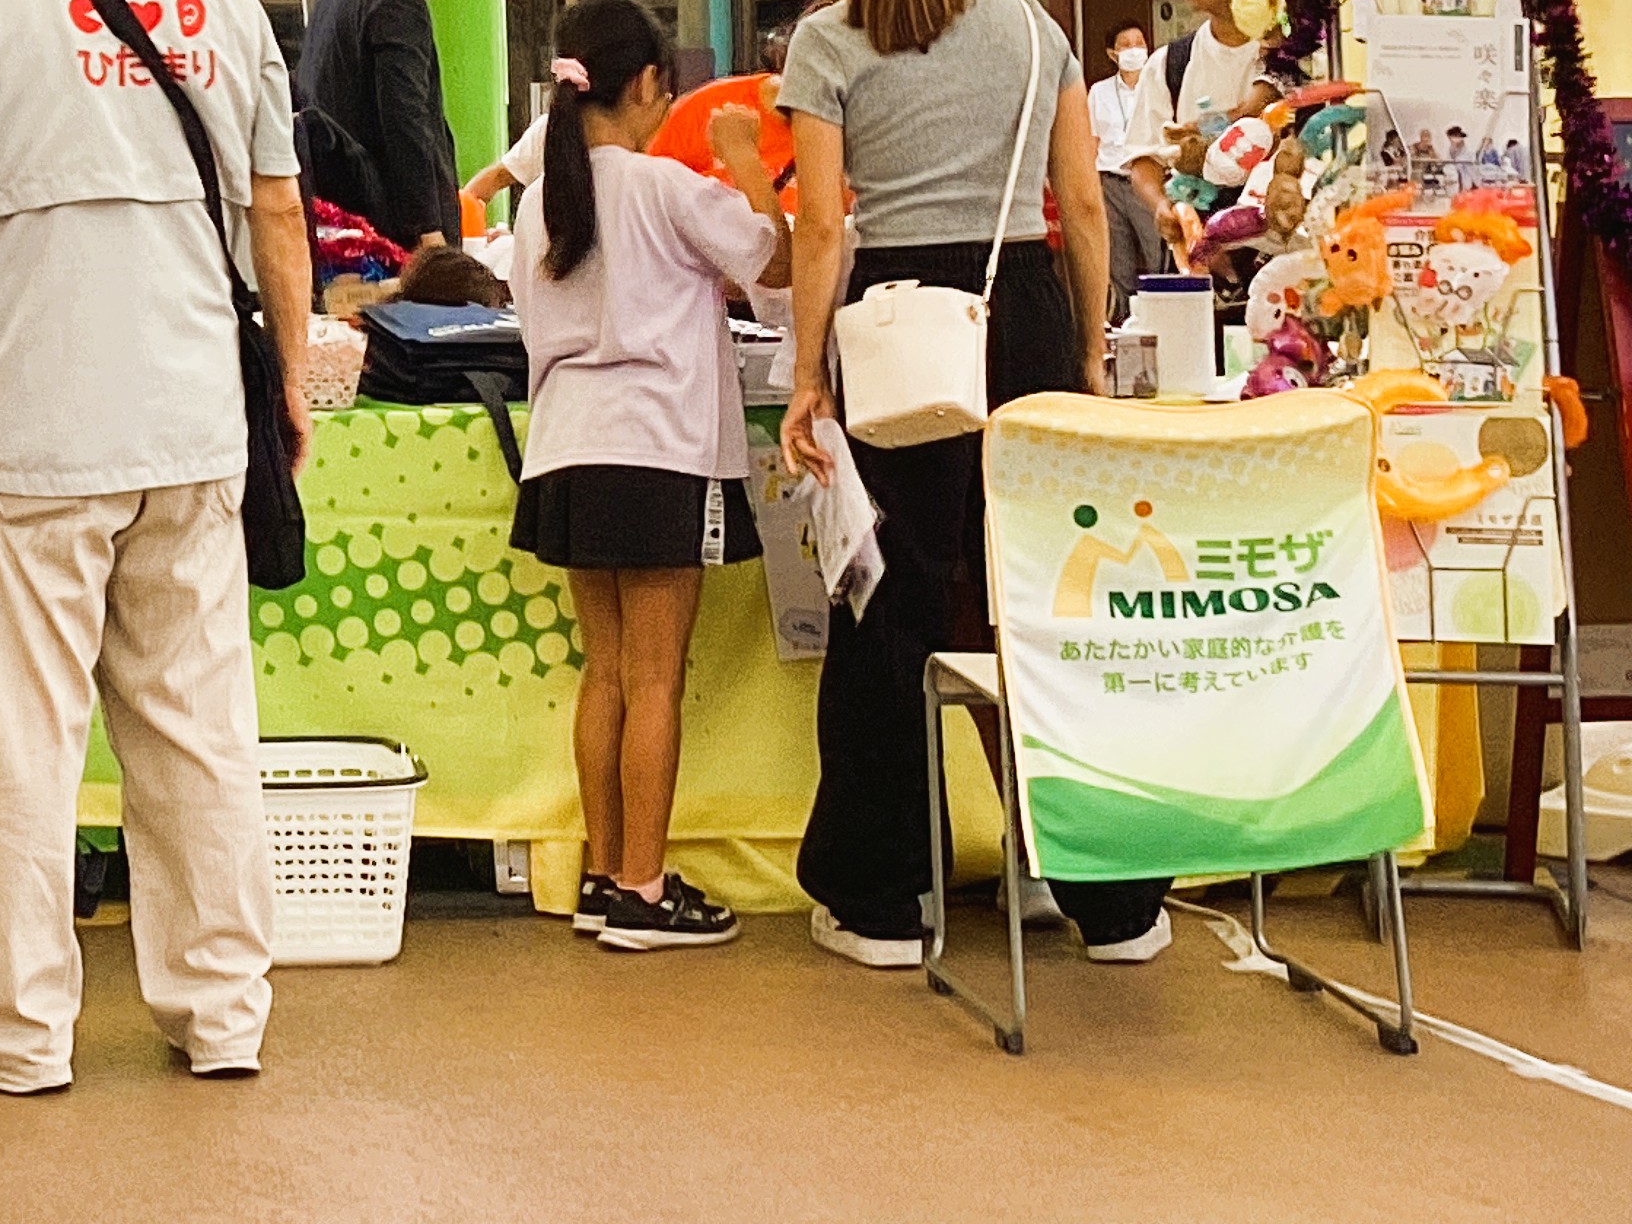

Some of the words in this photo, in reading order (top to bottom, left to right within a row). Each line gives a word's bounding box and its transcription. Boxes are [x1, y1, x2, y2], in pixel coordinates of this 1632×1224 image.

[1195, 529, 1334, 581] ミモザ
[1108, 582, 1341, 619] MIMOSA
[1059, 620, 1346, 662] あたたかい家庭的な介護を
[1101, 652, 1313, 695] 第一に考えています
